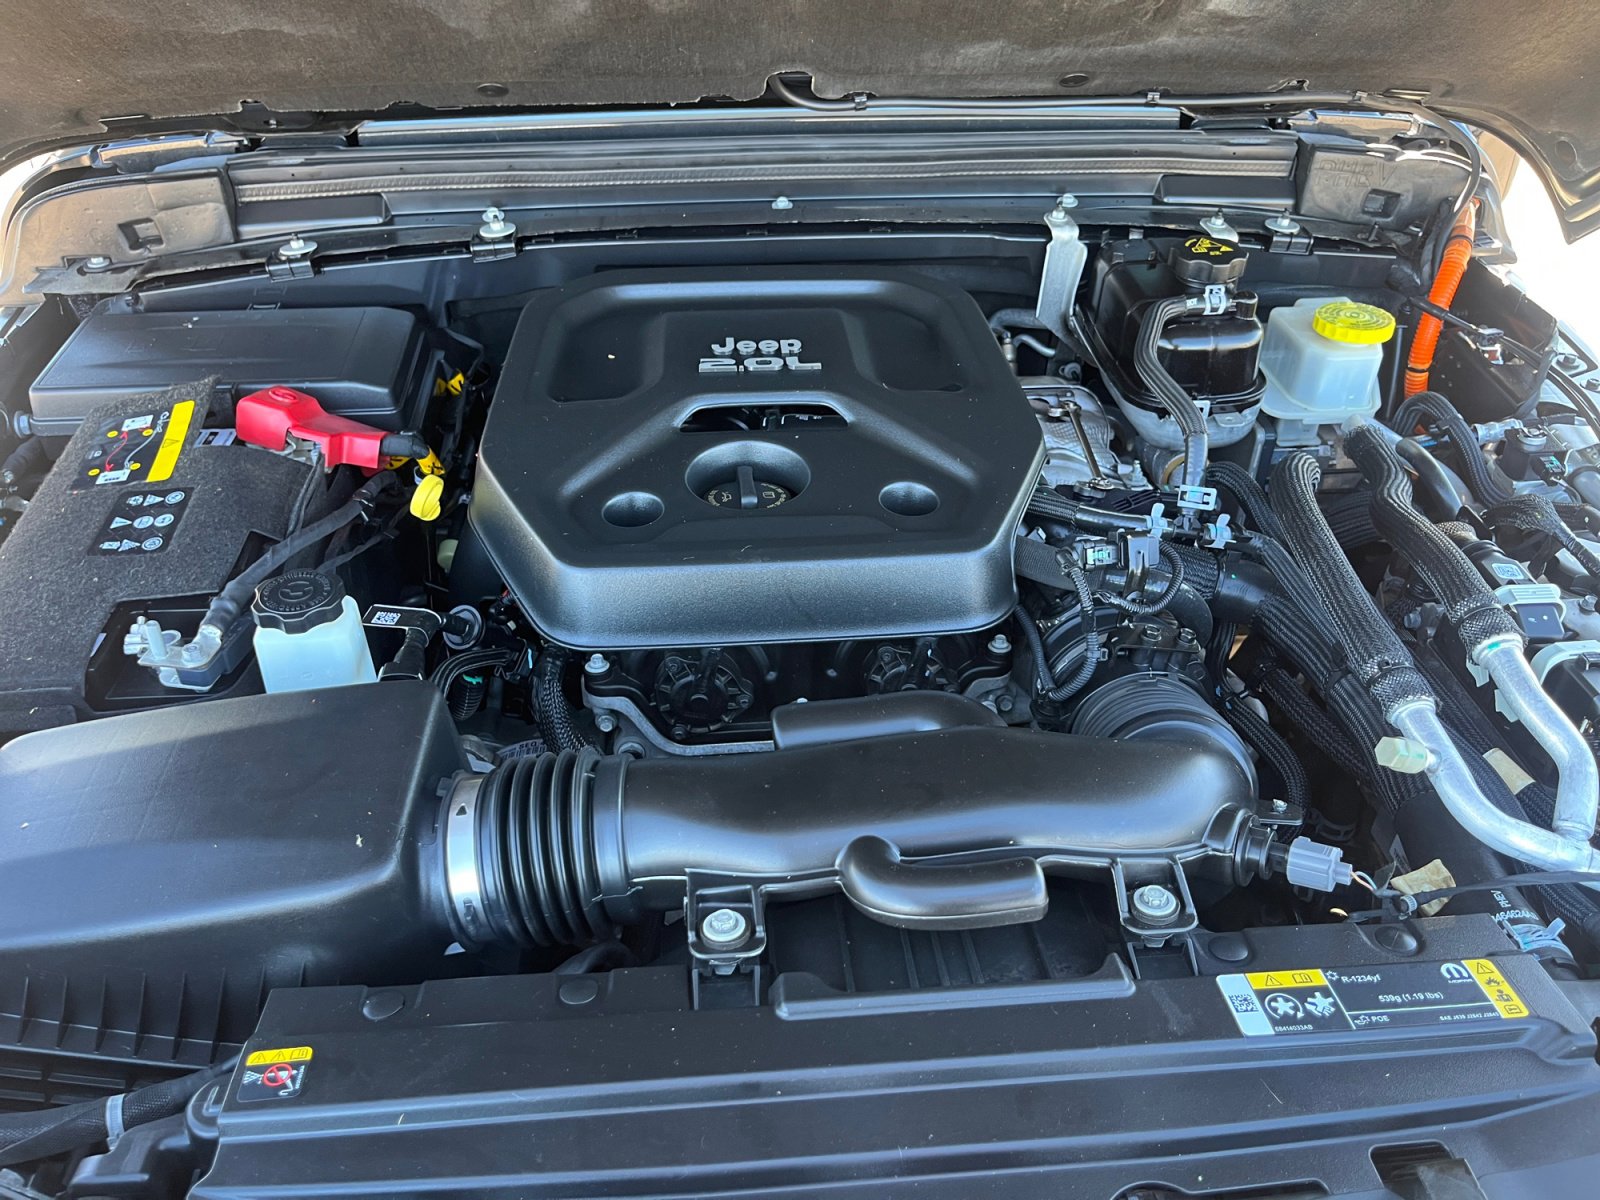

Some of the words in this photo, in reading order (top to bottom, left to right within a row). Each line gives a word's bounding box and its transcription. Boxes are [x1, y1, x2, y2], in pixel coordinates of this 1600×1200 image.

[710, 336, 802, 355] Jeep
[698, 356, 822, 373] 2.0L
[1490, 890, 1512, 908] PHEV
[1403, 992, 1425, 1003] (1.19
[1426, 991, 1444, 1000] lbs)
[1371, 1015, 1390, 1023] POE
